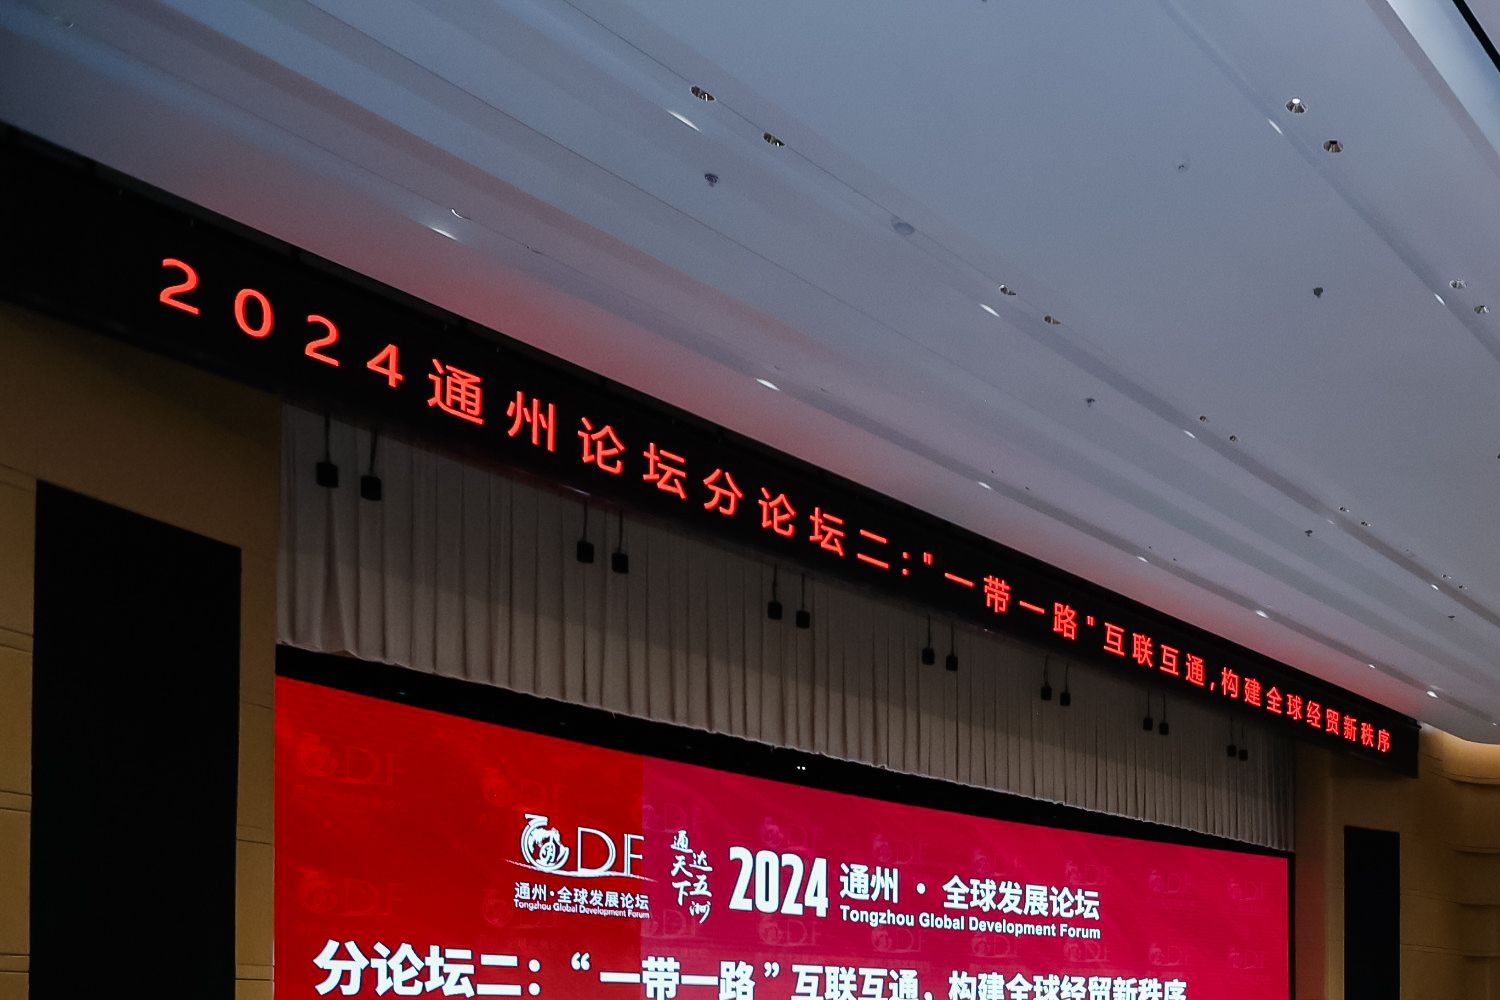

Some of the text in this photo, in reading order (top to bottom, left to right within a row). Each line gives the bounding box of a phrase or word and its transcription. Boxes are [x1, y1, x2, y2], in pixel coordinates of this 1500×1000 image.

[729, 846, 829, 918] 2024
[513, 898, 650, 919] Tongzhou Global Development Forum
[840, 904, 1101, 939] Tongzhou Global Development Forum
